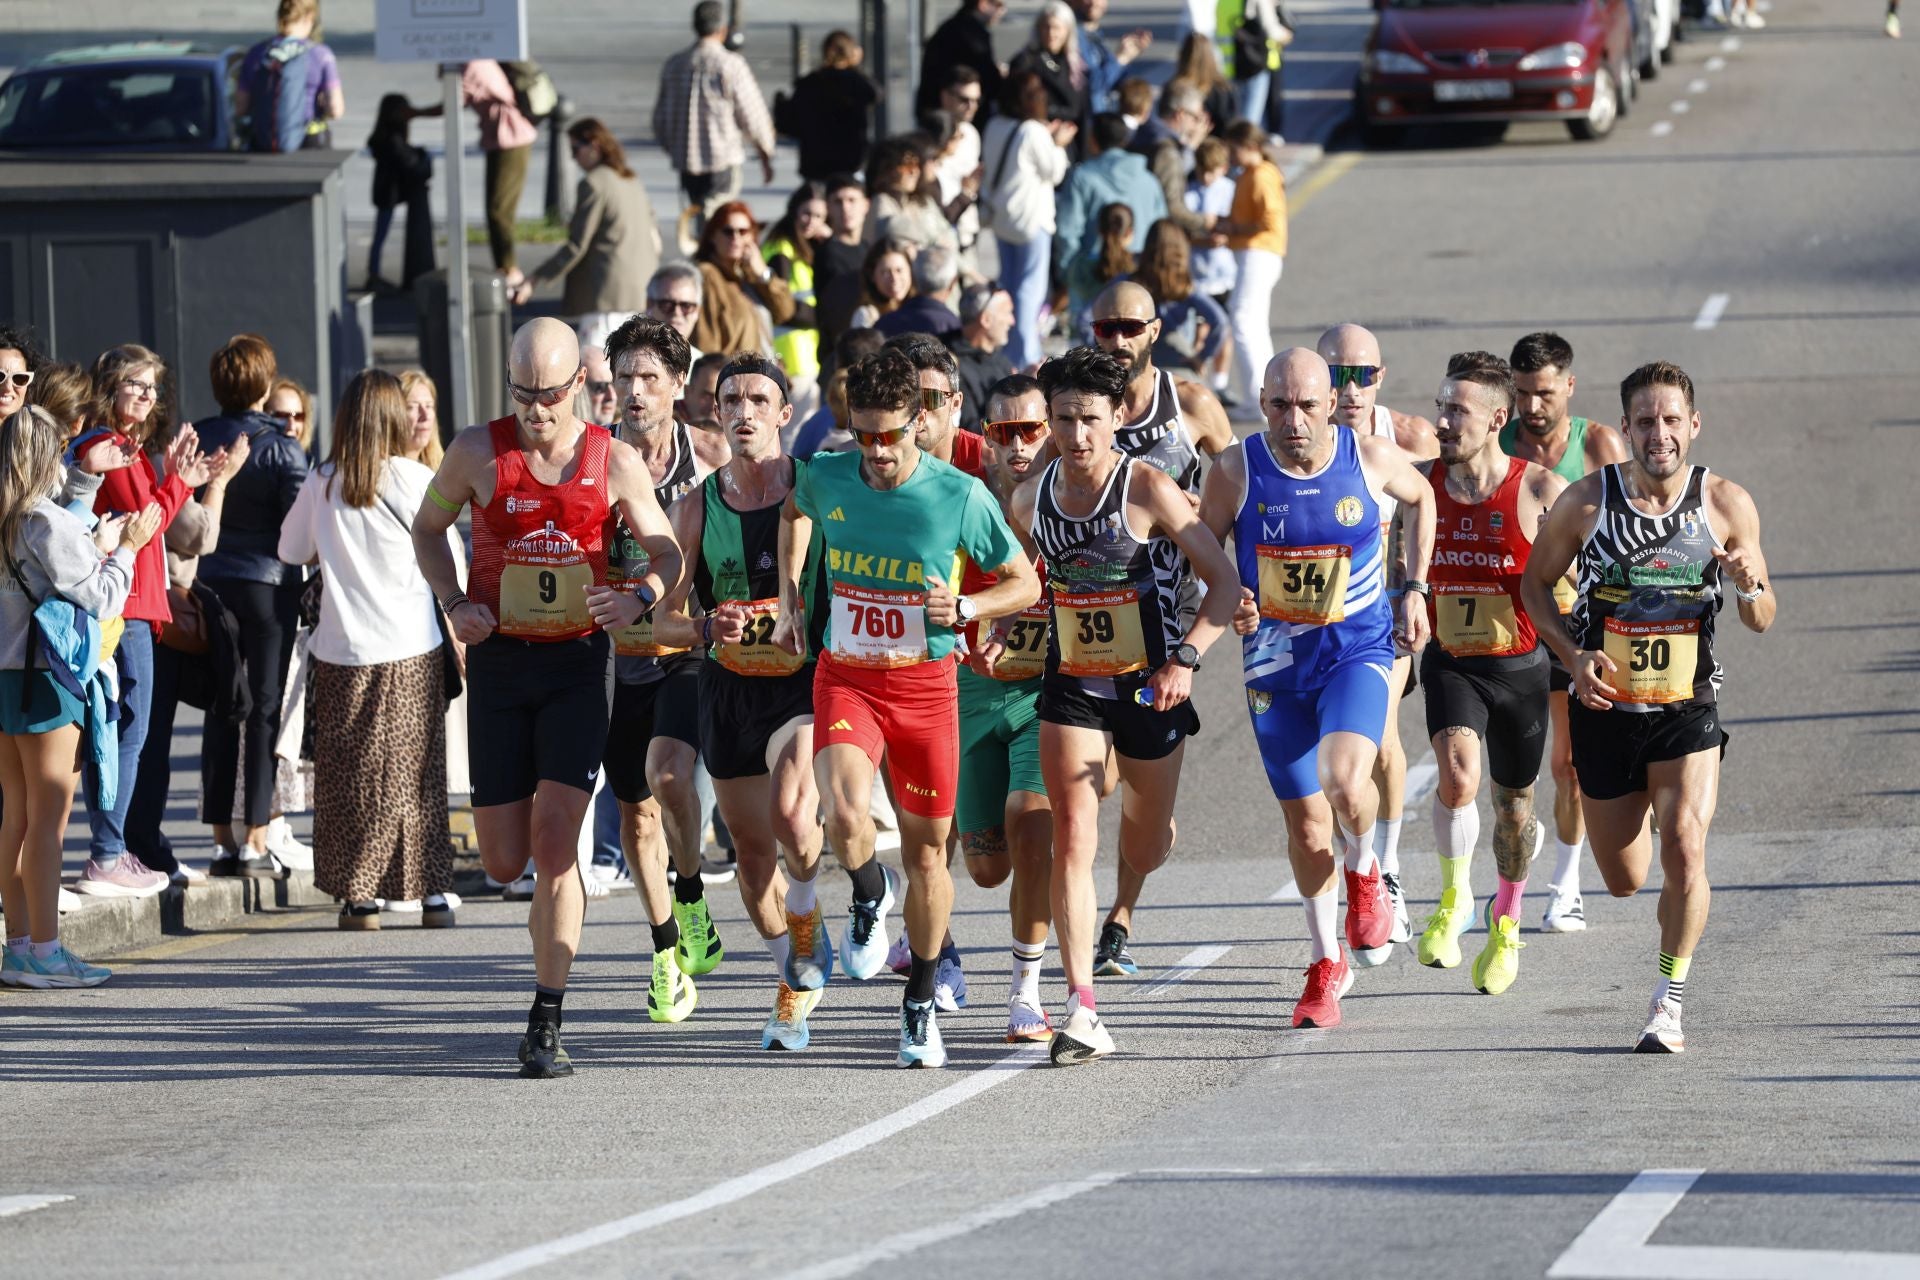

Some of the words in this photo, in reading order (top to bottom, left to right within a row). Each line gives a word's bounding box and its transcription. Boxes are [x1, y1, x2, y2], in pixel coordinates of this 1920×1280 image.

[1267, 504, 1289, 514] ence
[1262, 518, 1285, 541] M
[1453, 530, 1479, 541] Beco
[829, 548, 924, 585] BIKILA
[1058, 547, 1107, 562] RESTAURANTE
[1430, 546, 1516, 568] ÁRCOBA
[1630, 546, 1690, 563] RESTAURANTE
[1283, 563, 1326, 594] 34
[1600, 560, 1625, 585] LA
[1628, 560, 1704, 586] CEREZAL
[538, 570, 557, 604] 9
[856, 591, 873, 599] MBA
[1073, 597, 1089, 605] MBA
[1103, 595, 1124, 603] GIJÓN
[847, 602, 905, 639] 760
[1458, 598, 1477, 627] 7
[740, 616, 777, 647] 32
[1007, 620, 1048, 653] 37
[1076, 610, 1115, 645] 39
[1664, 623, 1685, 632] GIJÓN
[1629, 638, 1671, 672] 30
